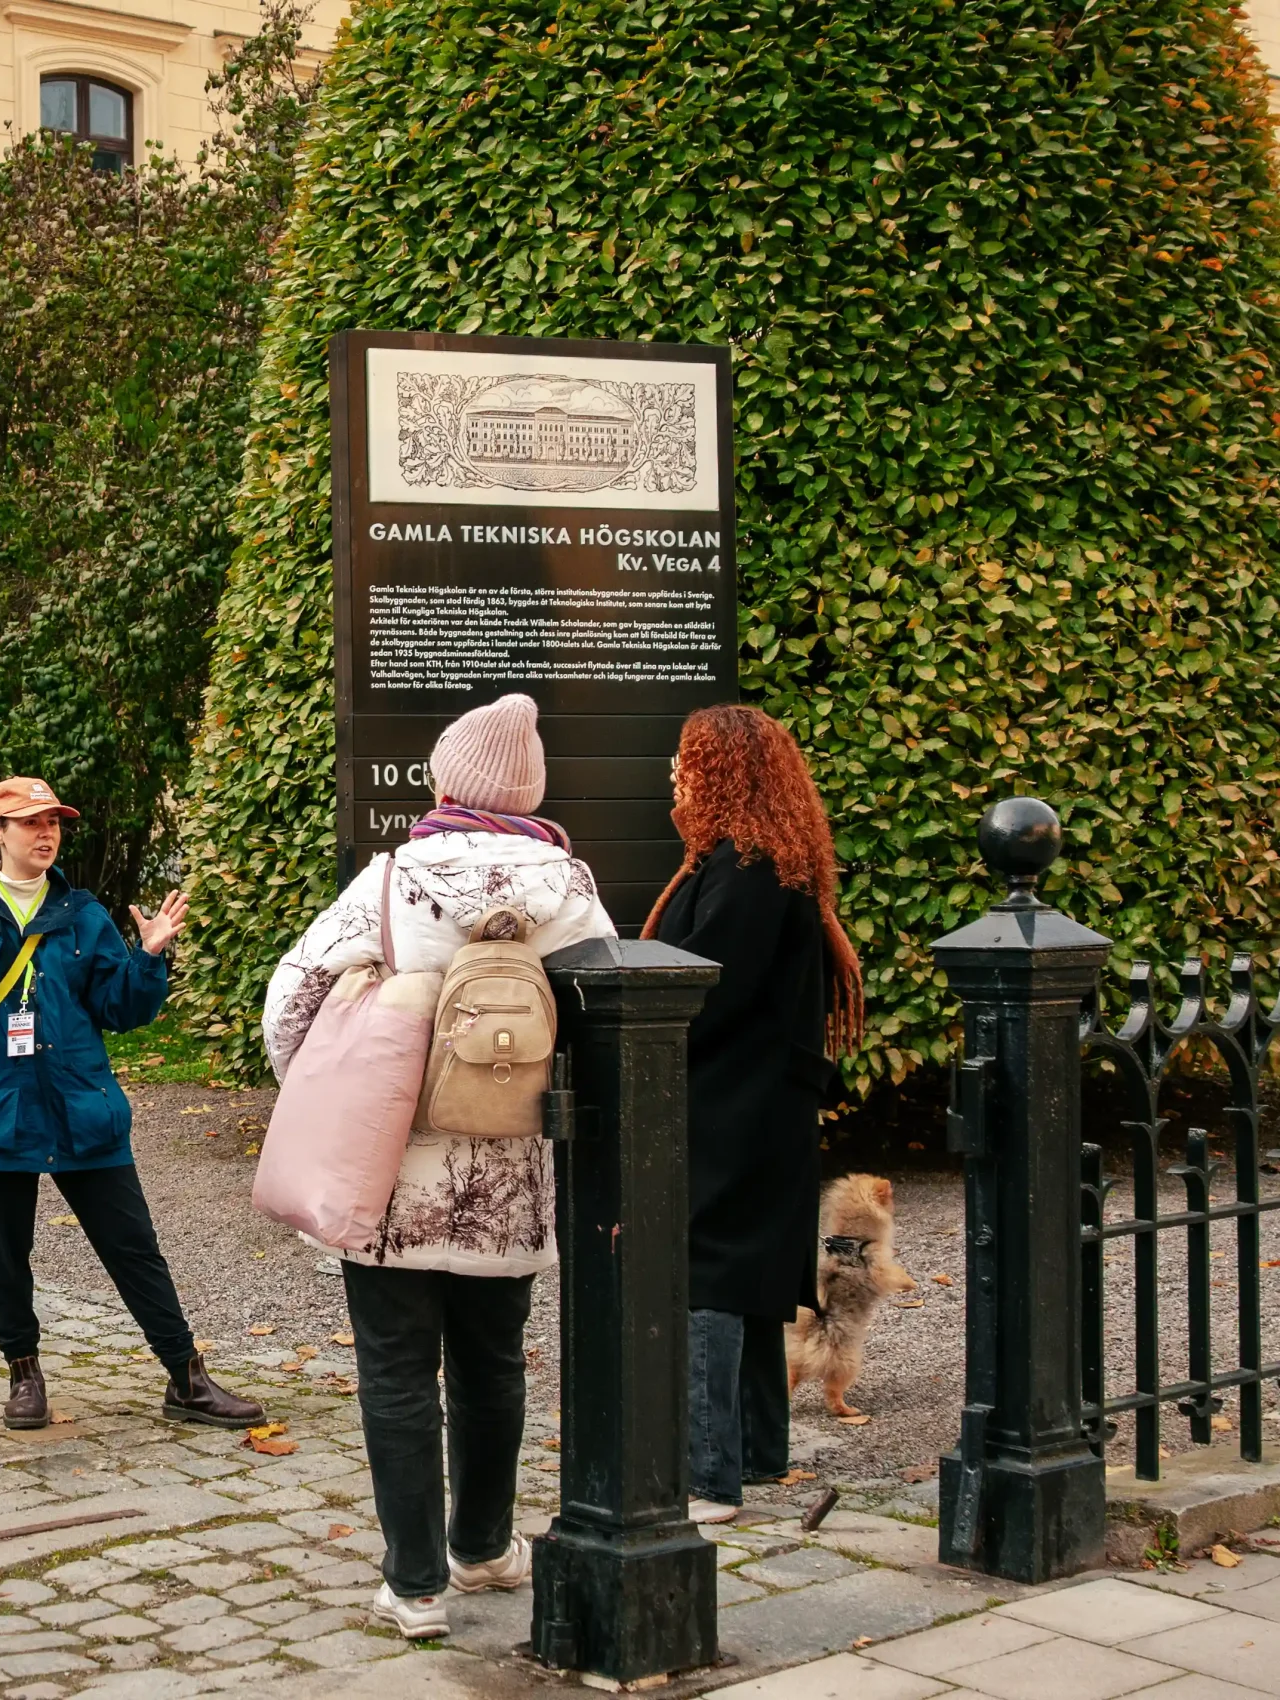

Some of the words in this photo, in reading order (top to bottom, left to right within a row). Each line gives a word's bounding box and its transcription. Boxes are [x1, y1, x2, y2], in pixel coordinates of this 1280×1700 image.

[369, 523, 452, 541] GAMLA
[460, 526, 571, 544] TEKNISKA
[580, 524, 720, 548] HÖGSKOLAN
[707, 555, 721, 572] 4
[428, 586, 467, 595] Högskolan
[510, 587, 533, 595] första,
[556, 588, 630, 598] institutionsbyggnader
[647, 590, 682, 599] uppfördes
[687, 591, 715, 600] Sverige.
[370, 596, 428, 605] Skolbyggnaden,
[463, 597, 485, 606] färdig
[508, 598, 539, 607] byggdes
[550, 599, 594, 608] Teknologiska
[596, 599, 627, 607] Institutet,
[695, 601, 711, 610] byta
[402, 607, 435, 616] Kungliga
[468, 608, 508, 617] Högskolan.
[560, 620, 601, 628] Scholander,
[633, 621, 673, 630] byggnaden
[370, 628, 417, 637] nyrenässans.
[439, 628, 483, 638] byggnadens
[484, 629, 524, 638] gestaltning
[572, 630, 612, 639] planlösning
[381, 638, 435, 648] skolbyggnader
[453, 639, 490, 648] uppfördes
[653, 642, 689, 651] Högskolan
[414, 649, 510, 659] byggnadsminnesförklarad.
[526, 661, 552, 669] framåt,
[587, 662, 614, 670] flyttade
[371, 670, 425, 679] Valhallavägen,
[440, 671, 482, 680] byggnaden
[483, 671, 506, 680] inrymt
[607, 672, 623, 681] idag
[624, 672, 654, 681] fungerar
[670, 673, 692, 682] gamla
[444, 681, 473, 690] företag.
[372, 764, 399, 786] 10
